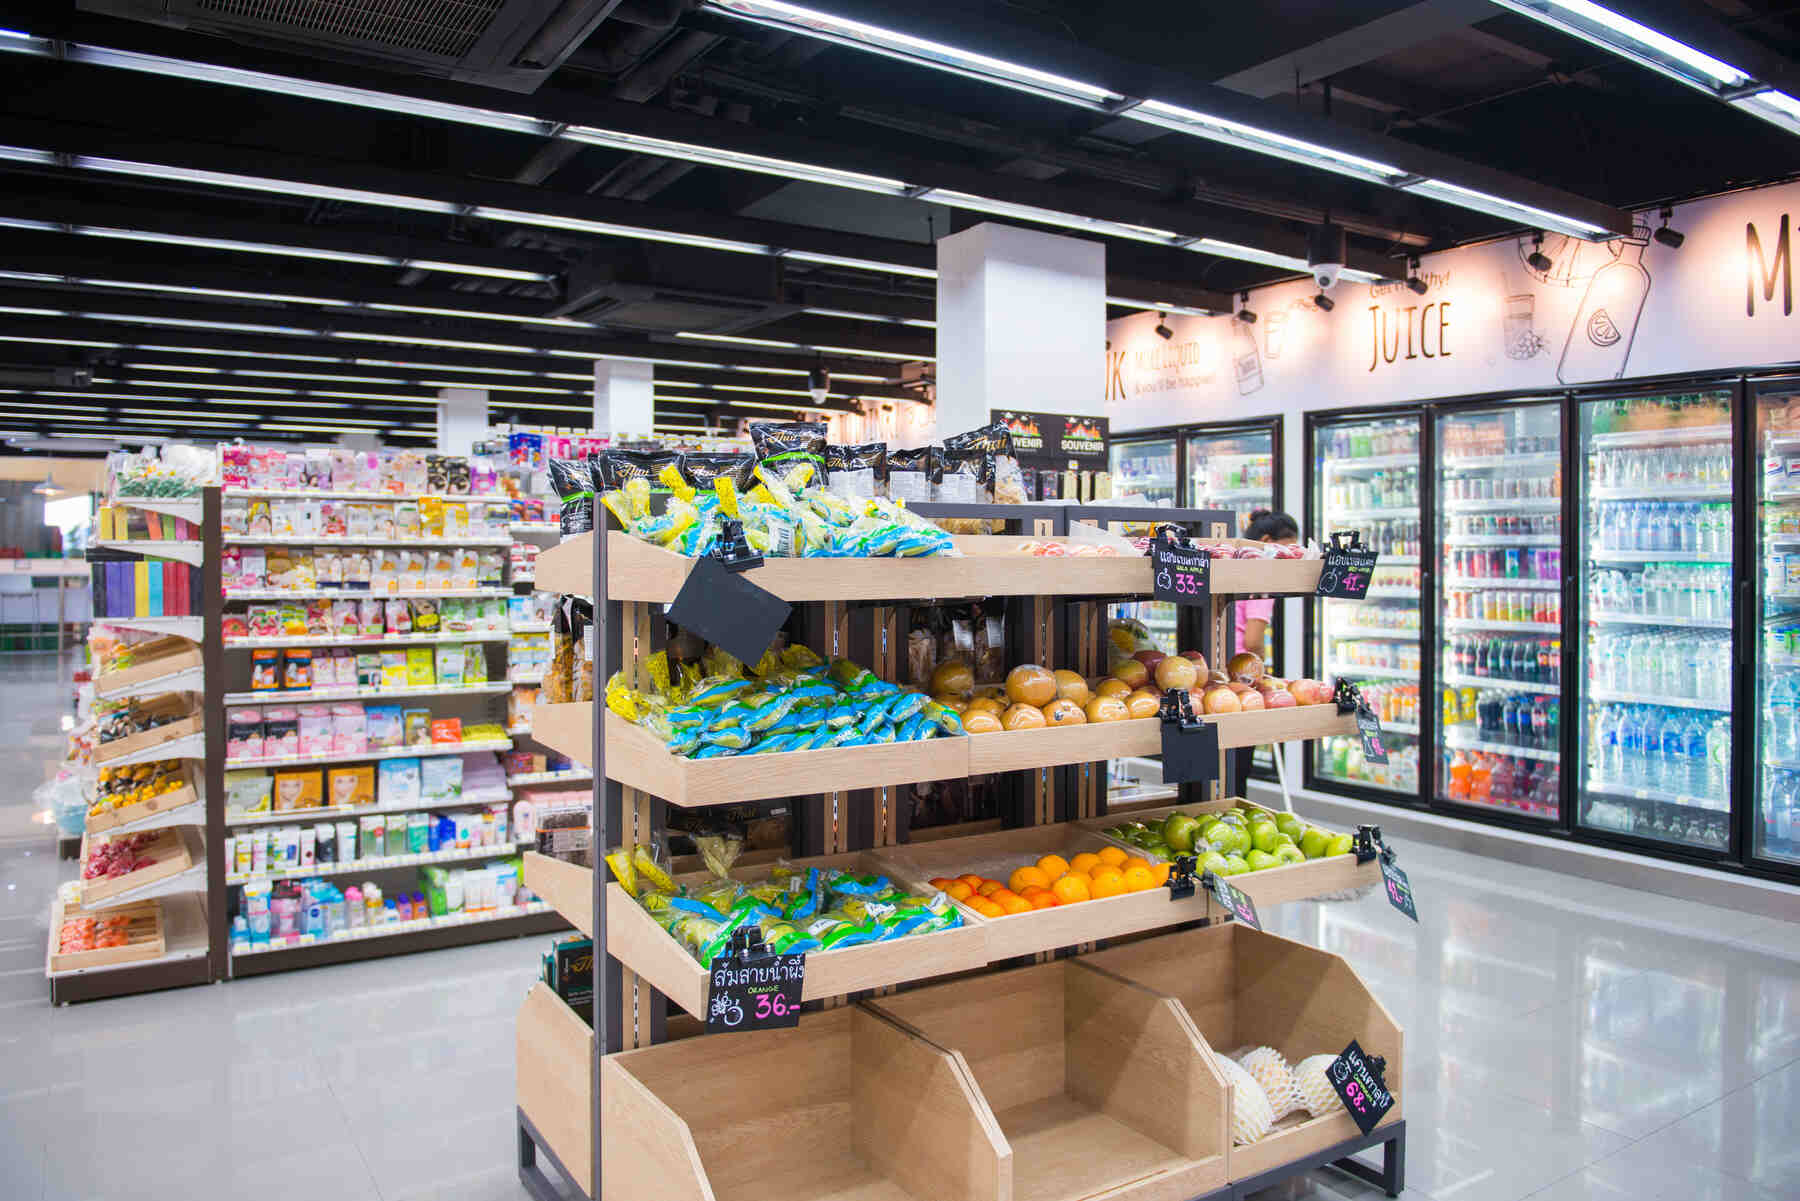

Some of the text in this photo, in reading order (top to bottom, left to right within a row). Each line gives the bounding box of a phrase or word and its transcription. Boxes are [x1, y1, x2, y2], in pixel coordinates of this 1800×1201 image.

[1746, 212, 1800, 318] M
[1368, 302, 1452, 373] JUICE
[1060, 439, 1105, 452] SOUVENIR
[747, 984, 781, 994] ORANGE
[754, 993, 801, 1019] 36.-
